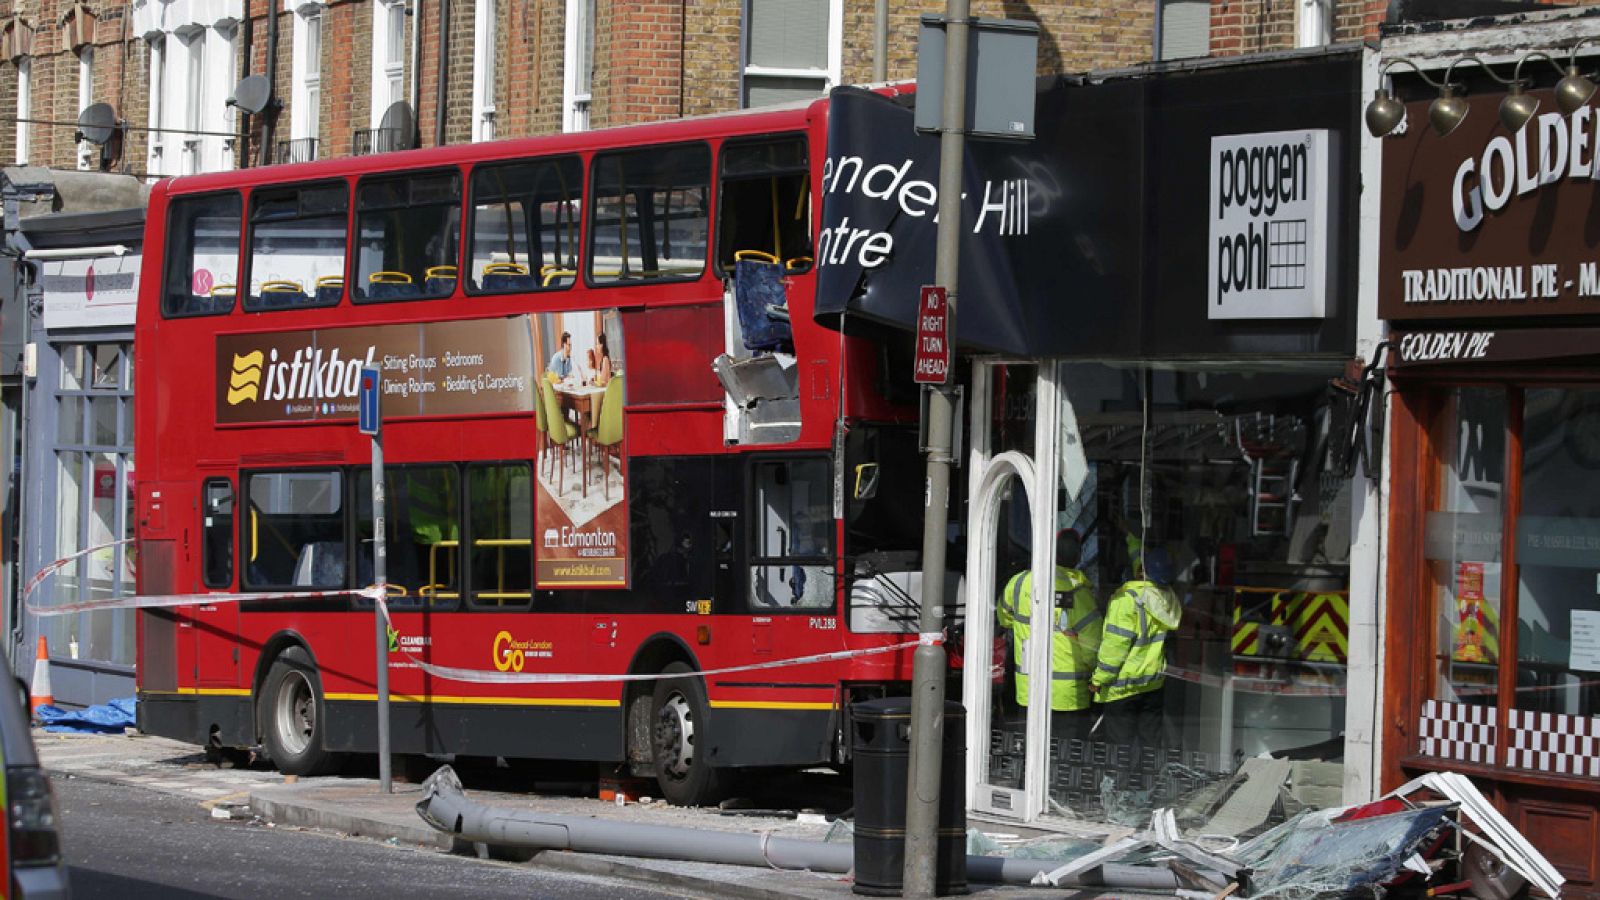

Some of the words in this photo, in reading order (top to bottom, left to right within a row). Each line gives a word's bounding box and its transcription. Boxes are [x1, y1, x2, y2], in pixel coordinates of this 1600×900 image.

[1219, 142, 1307, 219] poggen
[972, 178, 1028, 236] Hill
[1217, 222, 1269, 305] pohl
[1402, 266, 1528, 302] TRADITIONAL
[1531, 263, 1559, 297] PIE
[927, 293, 939, 309] NO
[922, 316, 944, 332] RIGHT
[923, 337, 943, 353] TURN
[1400, 332, 1467, 361] GOLDEN
[1463, 332, 1495, 359] PIE
[384, 354, 409, 373] Sitting
[409, 353, 437, 372] Groups
[445, 351, 484, 367] Bedrooms
[917, 359, 945, 375] AHEAD
[384, 378, 409, 397] Dining
[408, 377, 437, 393] Rooms
[446, 375, 478, 394] Bedding
[485, 373, 524, 392] Carpeting
[562, 526, 616, 547] Edmonton
